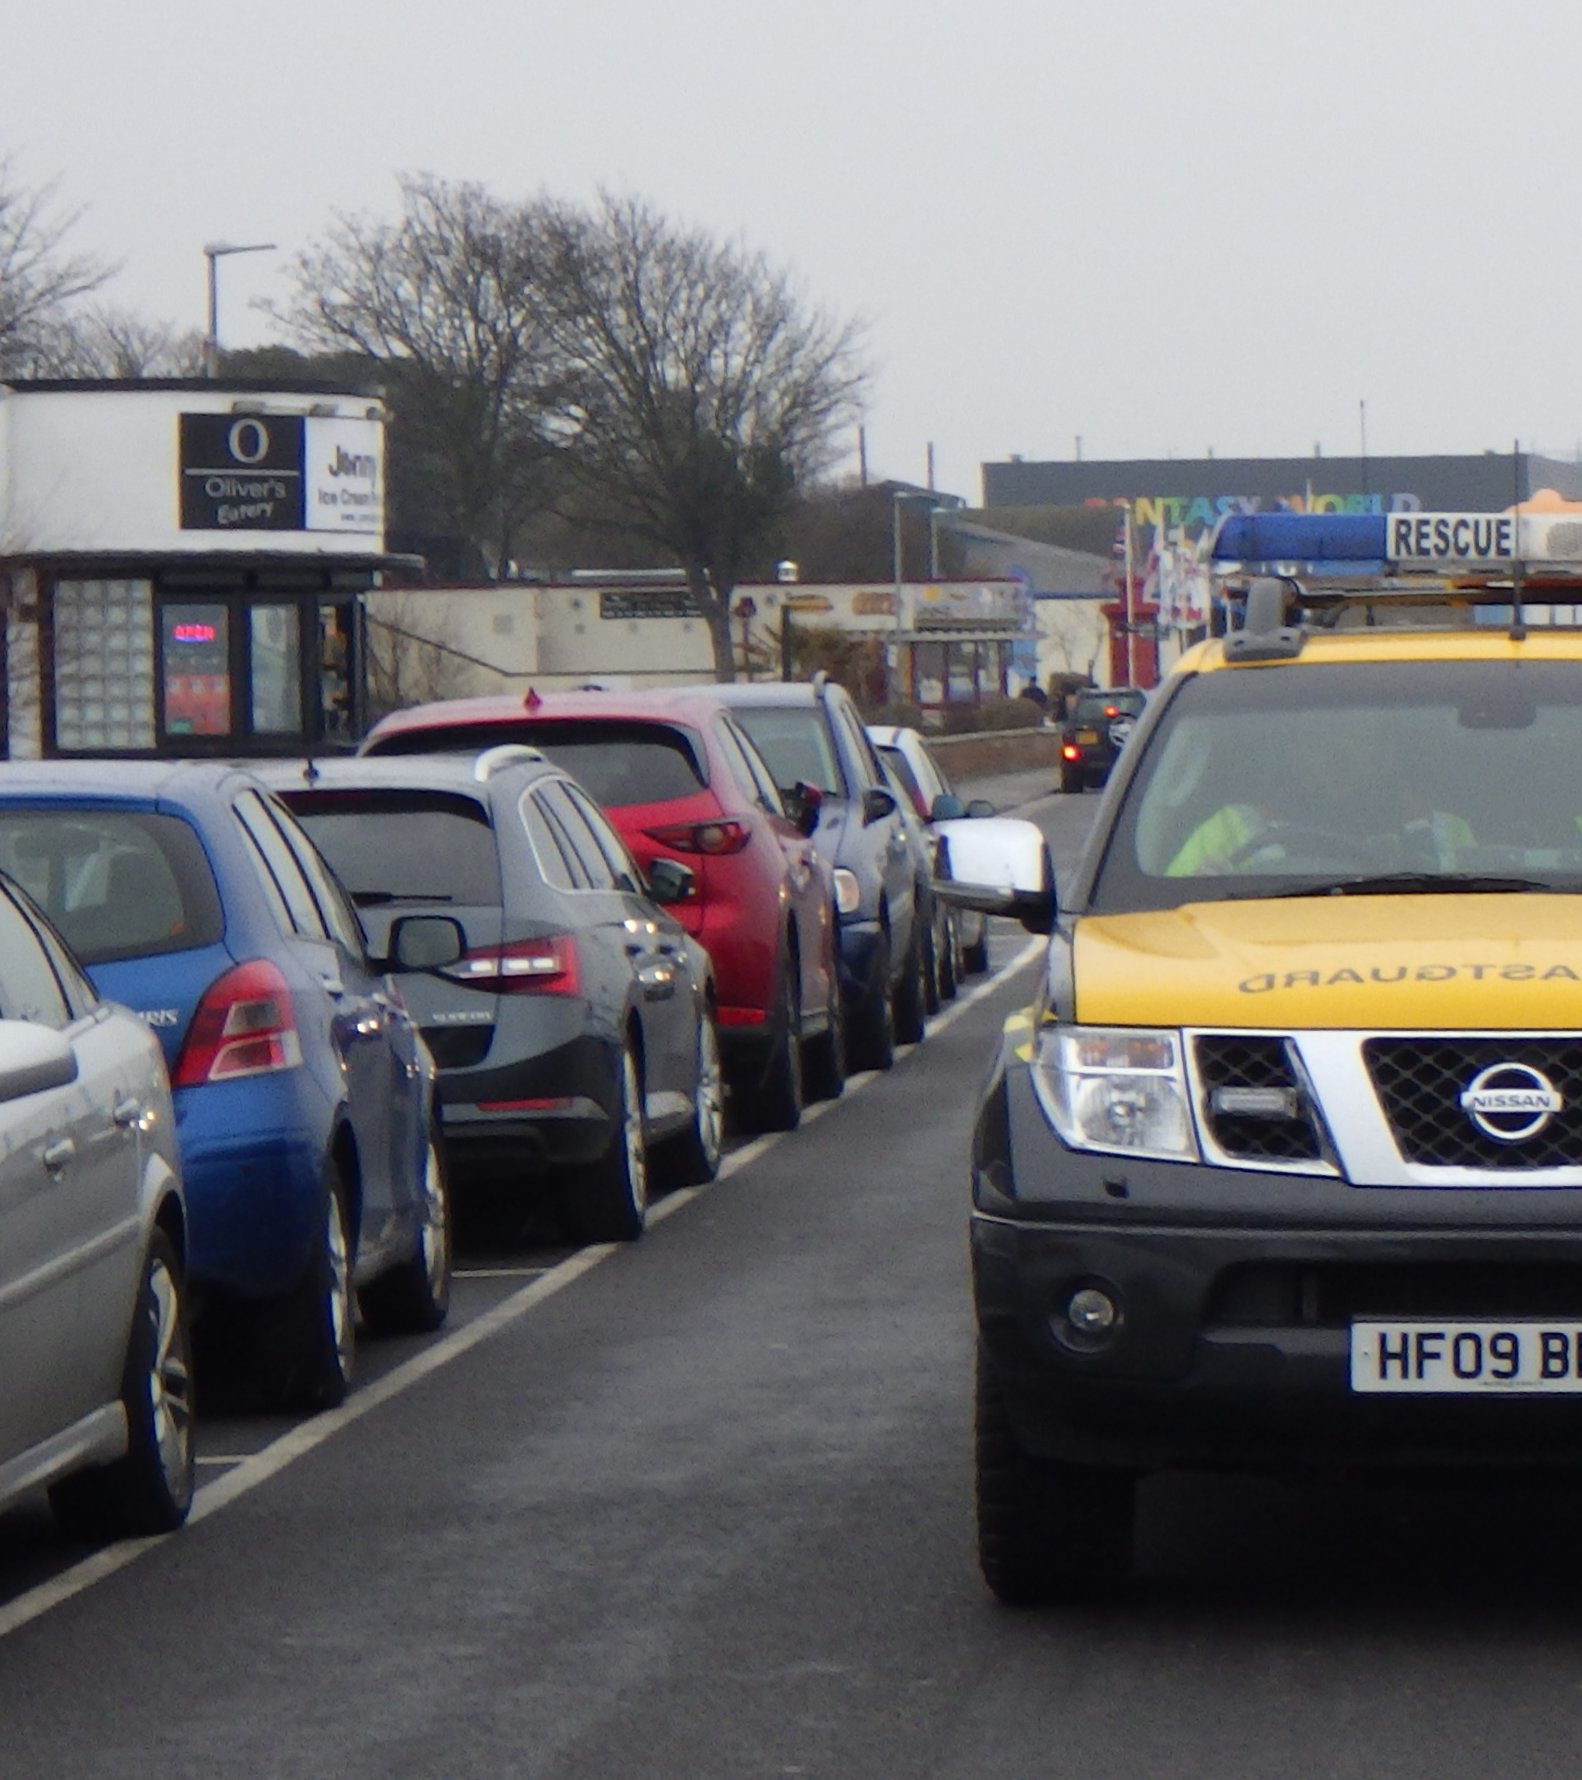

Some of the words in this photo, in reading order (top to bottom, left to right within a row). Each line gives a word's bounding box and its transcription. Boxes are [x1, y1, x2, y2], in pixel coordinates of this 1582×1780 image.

[229, 418, 269, 463] O
[205, 477, 286, 499] Oliver's
[217, 502, 274, 525] Eatery
[1086, 496, 1262, 527] NTASY
[1395, 518, 1511, 557] RESCUE
[1473, 1094, 1550, 1108] NISSAN
[1378, 1331, 1520, 1379] HF09
